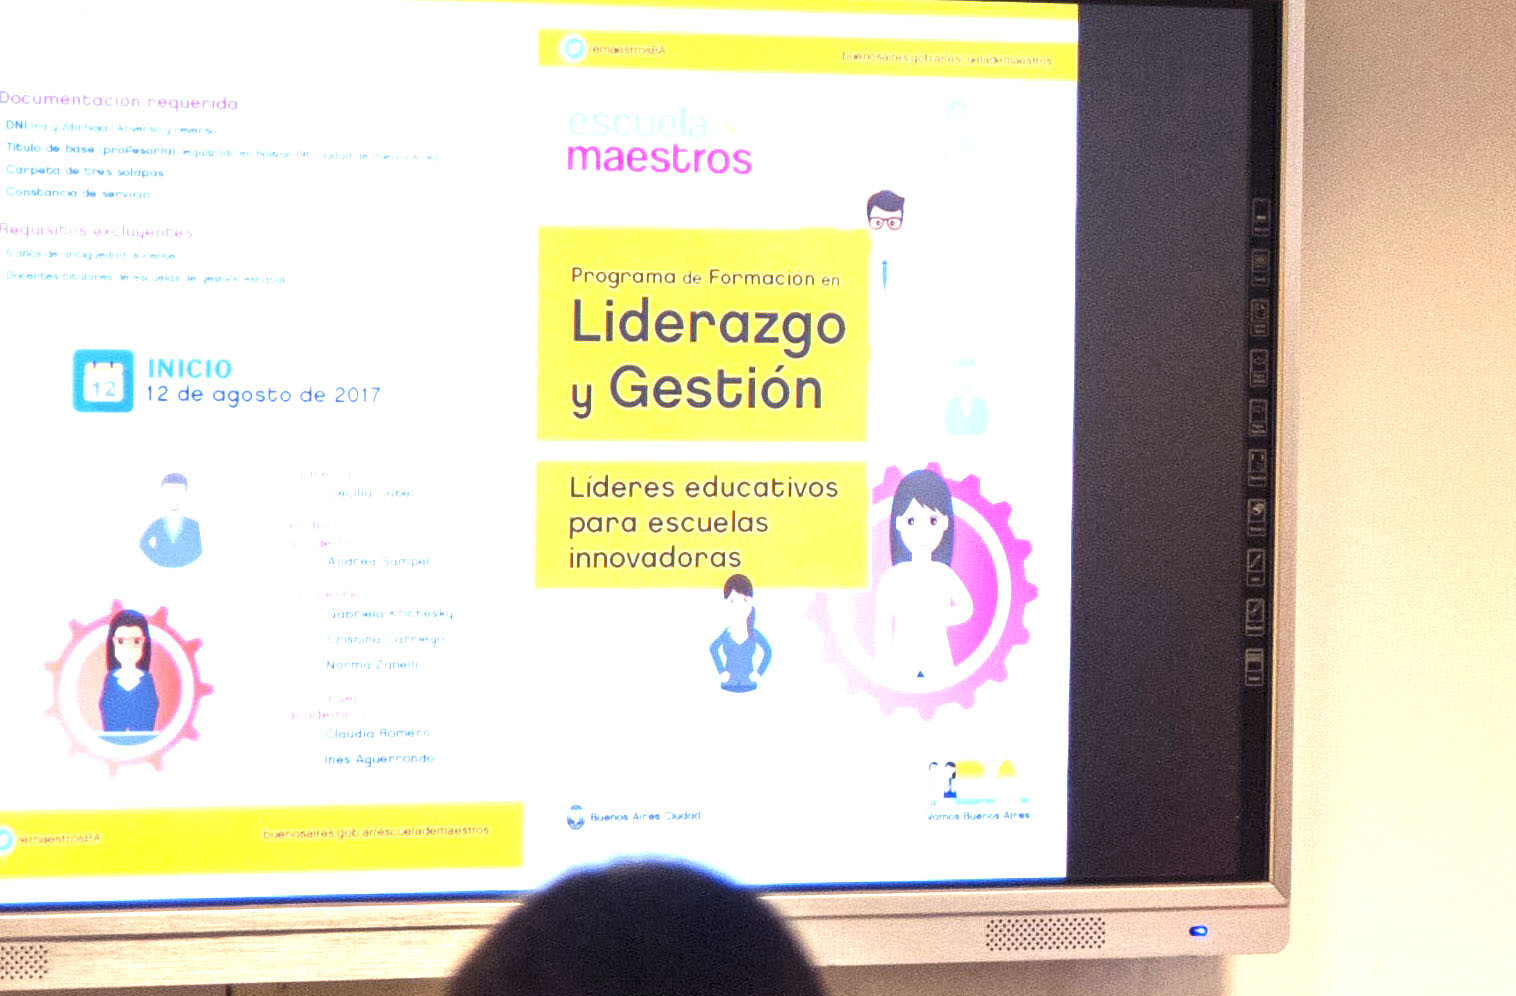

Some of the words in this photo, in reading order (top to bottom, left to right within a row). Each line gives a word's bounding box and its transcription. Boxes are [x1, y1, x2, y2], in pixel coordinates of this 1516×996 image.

[148, 96, 239, 112] requerida
[6, 119, 28, 130] DNI
[568, 106, 708, 139] escuela
[46, 143, 60, 153] de
[65, 143, 95, 154] base
[568, 143, 753, 175] maestros
[6, 163, 60, 177] Carpeta
[65, 166, 79, 176] de
[84, 167, 113, 178] tres
[117, 168, 165, 180] solapas
[6, 186, 78, 198] Constancia
[82, 188, 97, 198] de
[102, 188, 150, 200] servicio
[571, 266, 677, 289] Programa
[682, 270, 702, 285] de
[821, 273, 840, 287] en
[572, 297, 847, 359] Liderazgo
[148, 358, 233, 379] INICIO
[93, 380, 117, 397] 12
[147, 385, 169, 402] 12
[177, 385, 203, 402] de
[212, 386, 291, 408] agosto
[299, 386, 326, 403] de
[334, 386, 381, 404] 2017
[571, 383, 593, 419] y
[610, 364, 823, 410] Gestión
[569, 475, 676, 499] Líderes
[685, 475, 839, 499] educativos
[569, 514, 637, 539] para
[648, 510, 769, 533] escuelas
[569, 546, 742, 570] innovadoras
[326, 659, 371, 671] Norma
[325, 727, 375, 739] Claudia
[379, 727, 432, 739] Romero
[356, 754, 436, 768] Aguerrondo
[590, 812, 629, 822] Buenos
[632, 812, 661, 821] Aires
[663, 811, 701, 821] Ciudad
[963, 811, 1000, 821] Buenos
[1003, 811, 1031, 820] Aires
